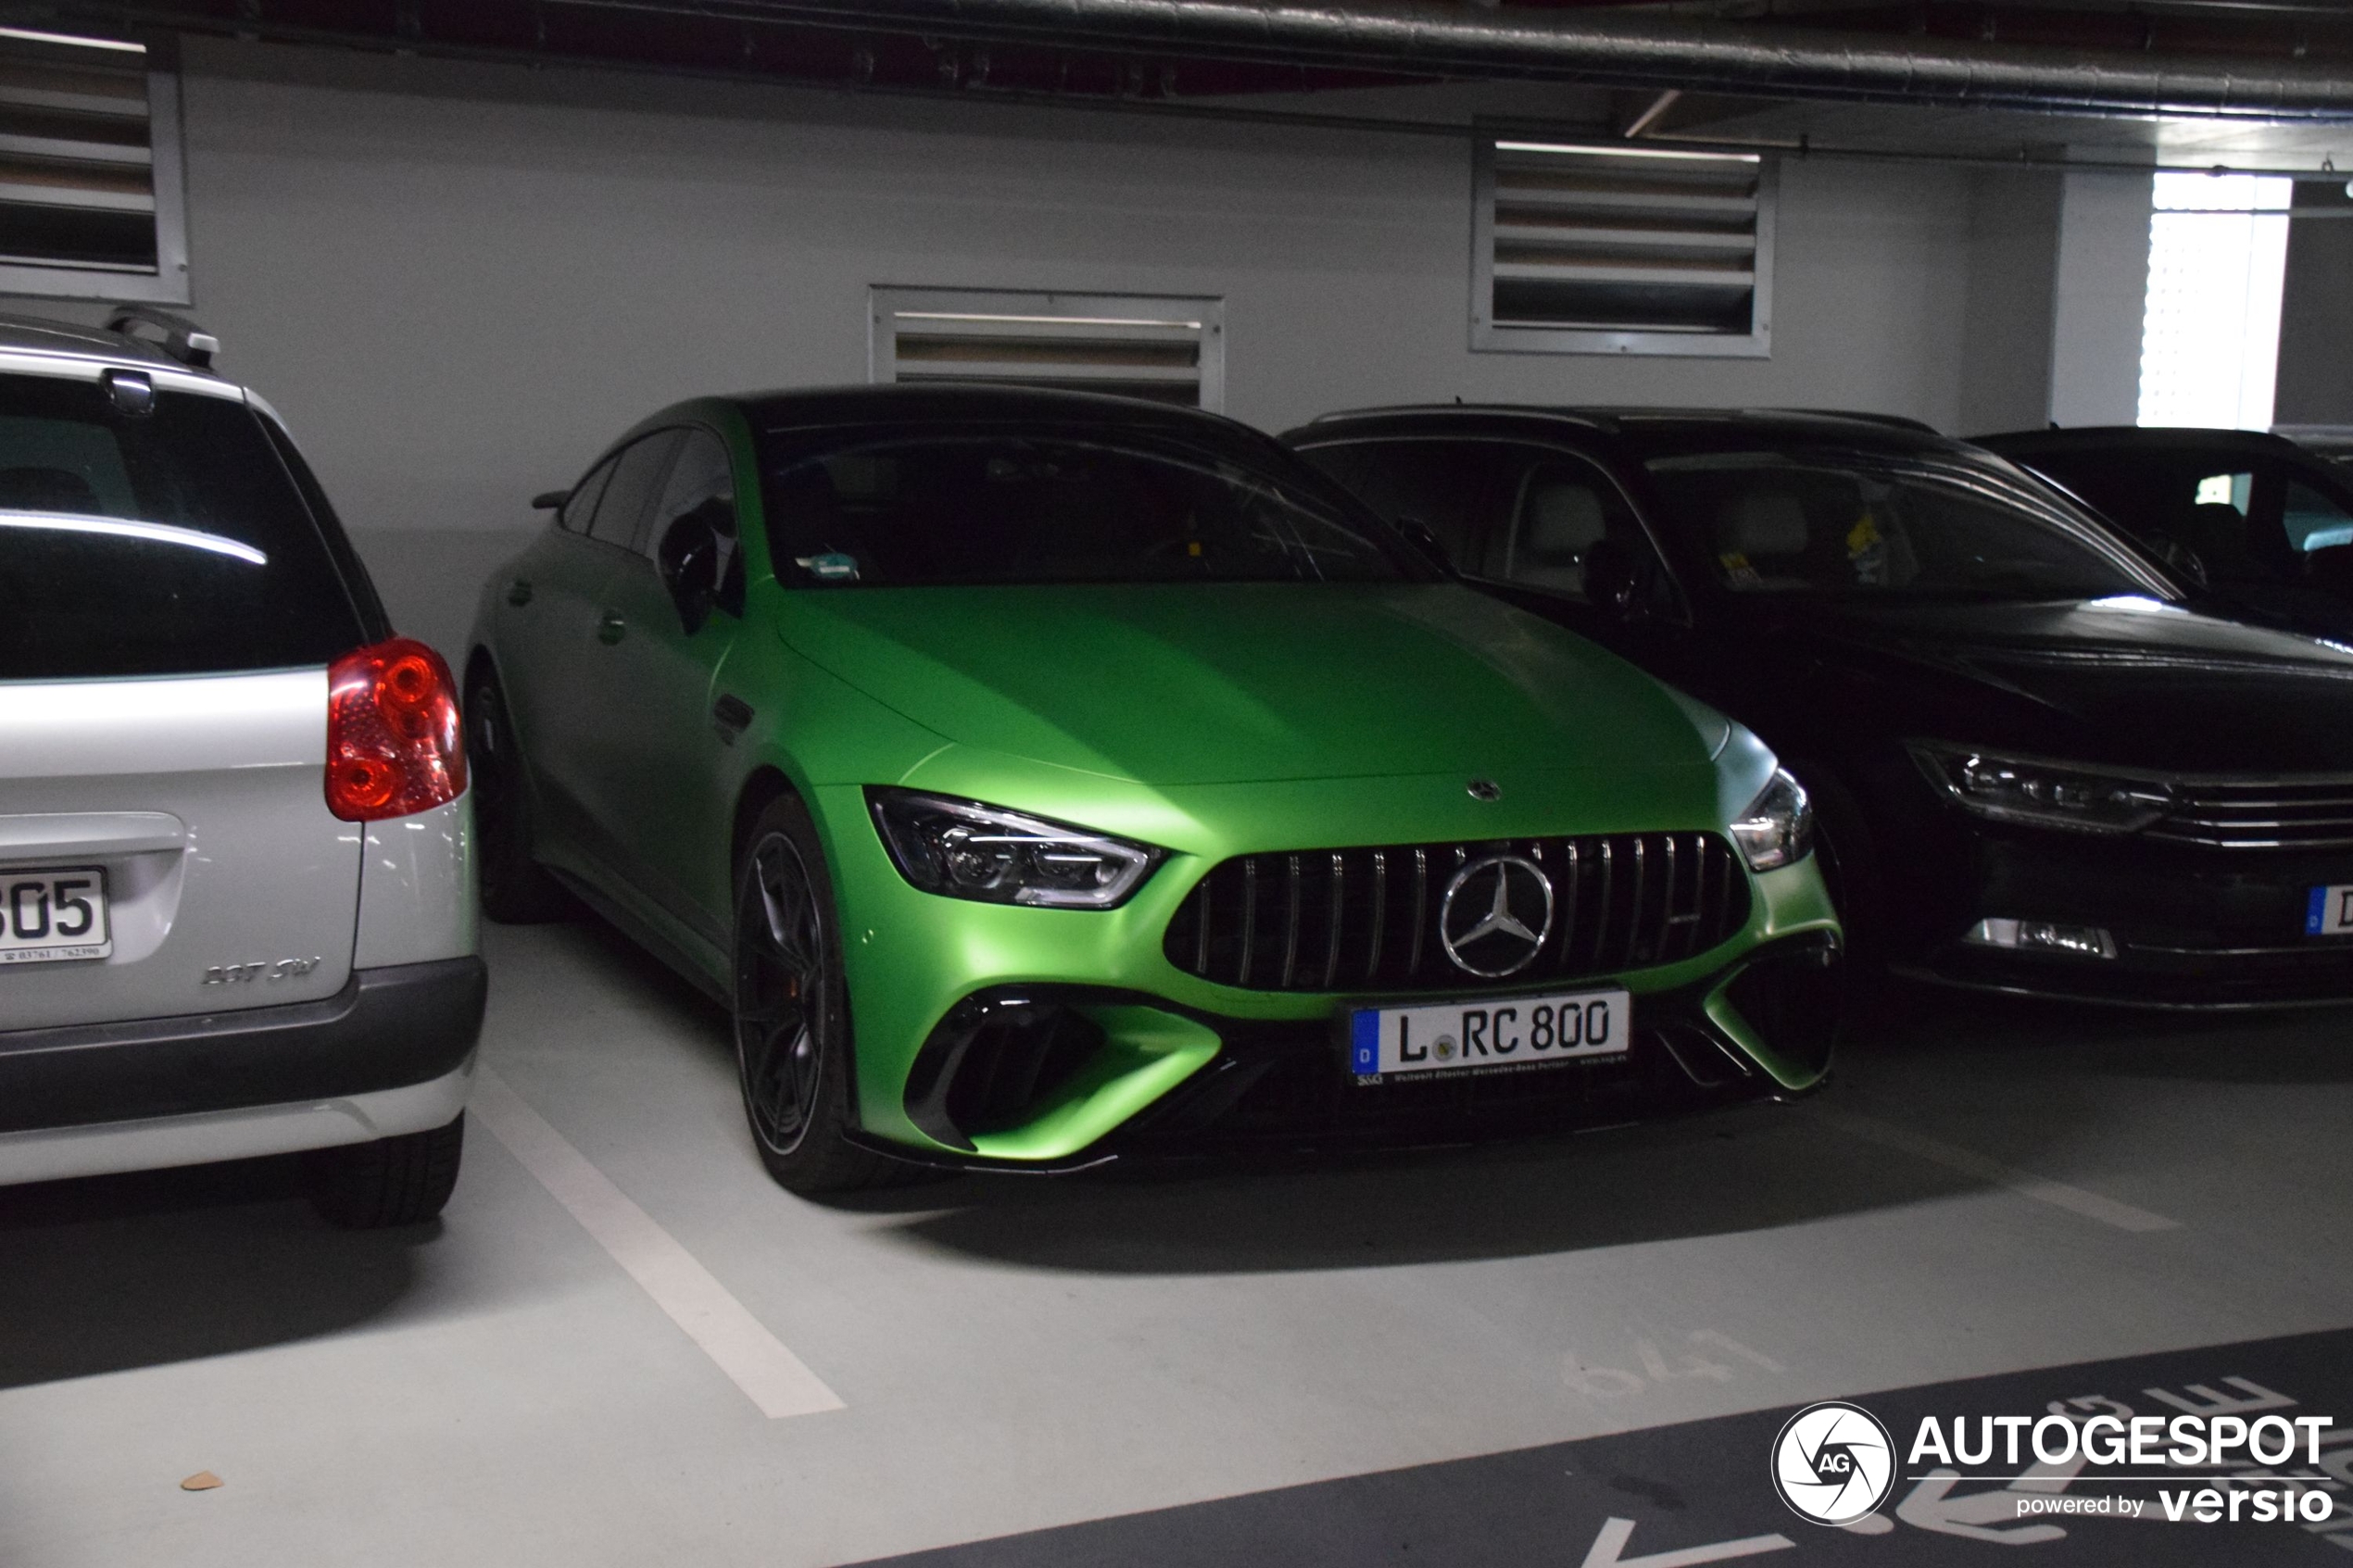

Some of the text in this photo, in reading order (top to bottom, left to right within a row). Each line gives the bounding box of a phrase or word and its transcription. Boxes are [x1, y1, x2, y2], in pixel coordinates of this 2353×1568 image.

[0, 880, 93, 939] 05
[19, 950, 50, 960] 03761
[1400, 1000, 1610, 1062] L RC 800
[1359, 1048, 1370, 1063] D
